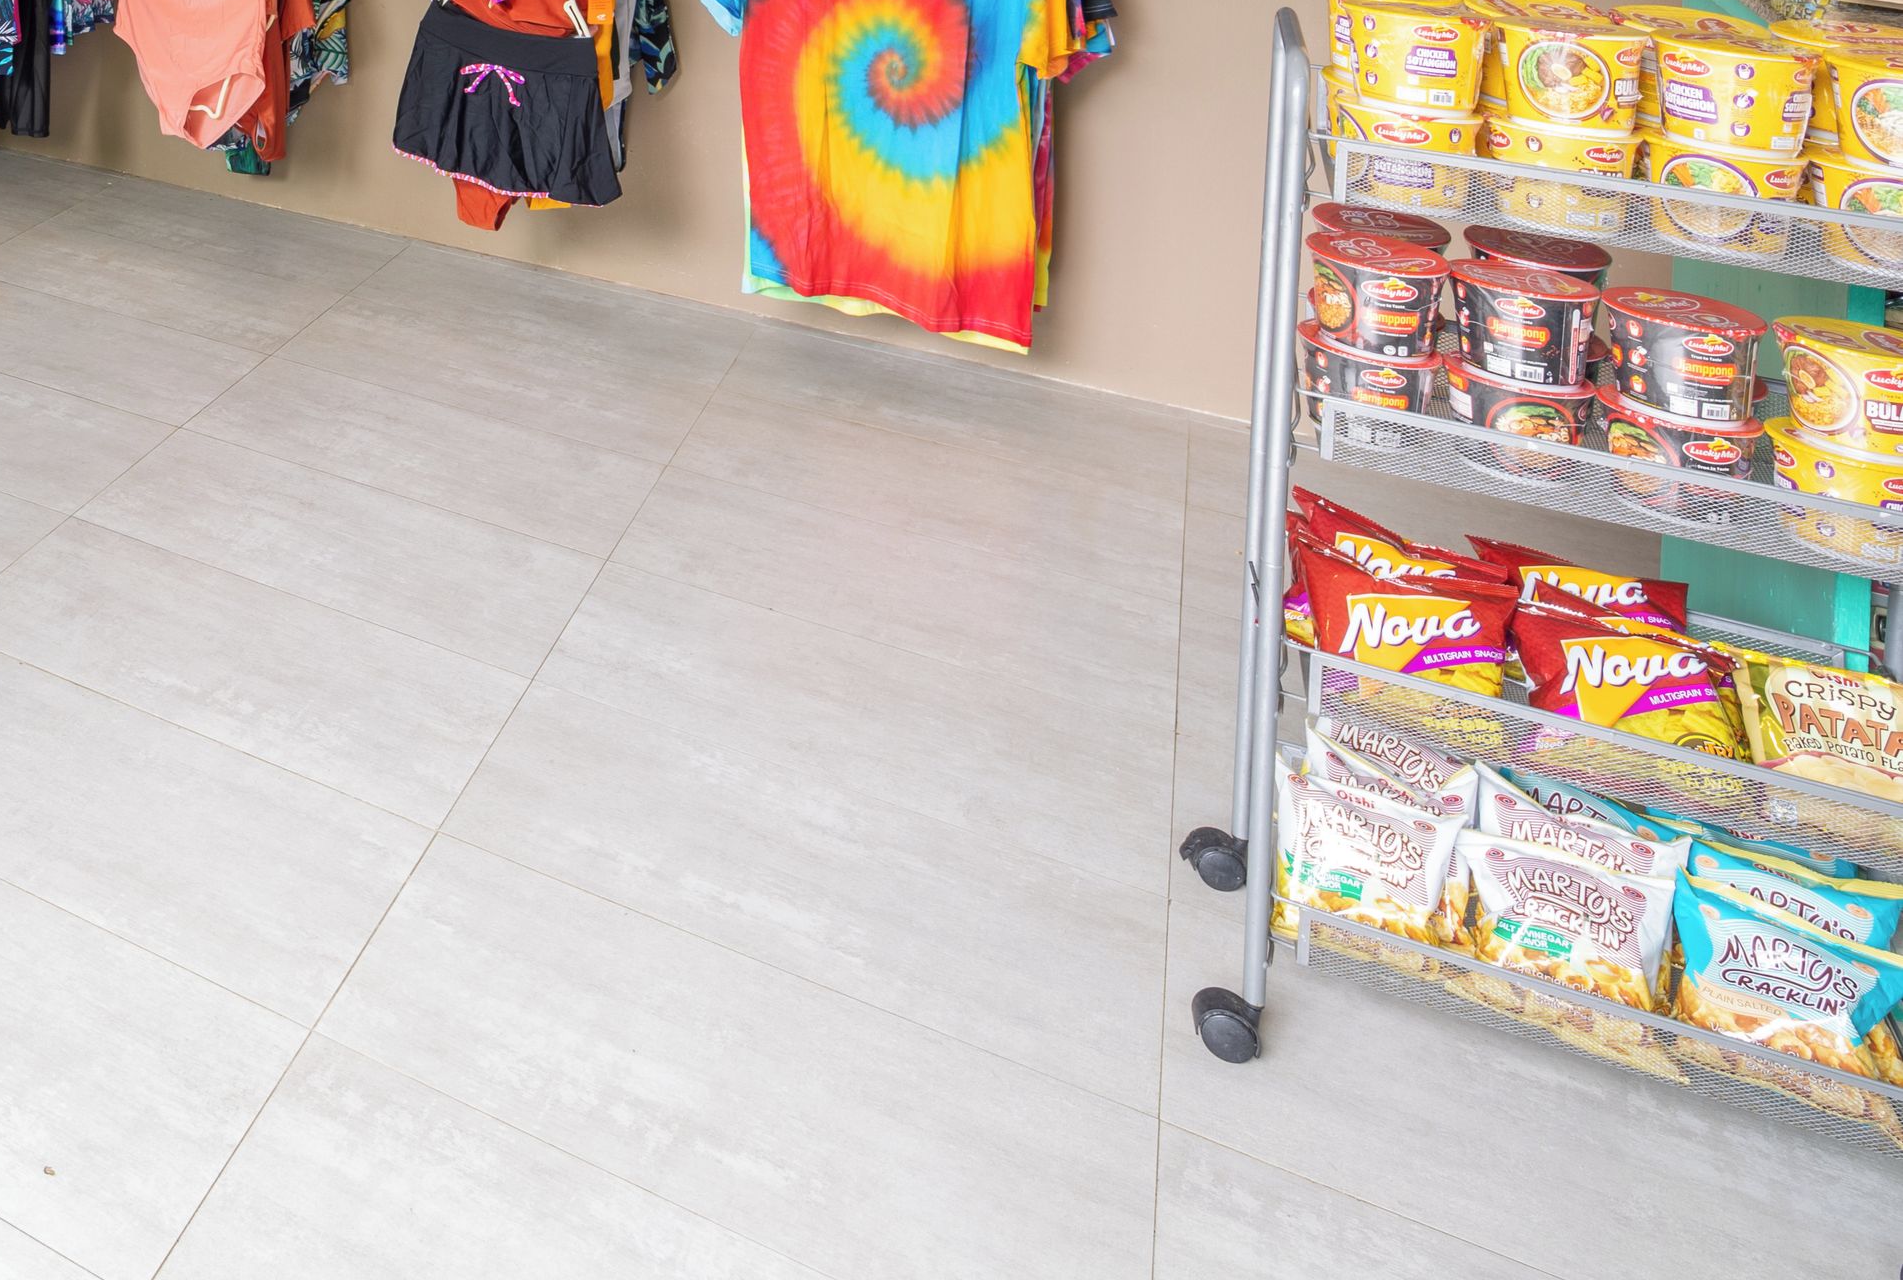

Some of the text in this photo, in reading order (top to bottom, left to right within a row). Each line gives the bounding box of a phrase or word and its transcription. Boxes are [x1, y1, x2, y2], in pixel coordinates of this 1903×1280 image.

[1406, 53, 1457, 70] SOTANGHON
[1416, 47, 1449, 60] CHICKEN
[1678, 360, 1734, 378] Jjamppong
[1871, 373, 1903, 386] Lucky
[1866, 400, 1903, 421] BULA
[1338, 539, 1457, 579] No
[1338, 603, 1481, 654] Nova
[1423, 649, 1506, 665] MULTIGRAIN SNACKS
[1561, 644, 1707, 694] Nova
[1650, 689, 1702, 705] MULTIGRAIN
[1336, 790, 1375, 810] Oishi
[1702, 986, 1782, 1017] PLAIN SALTED
